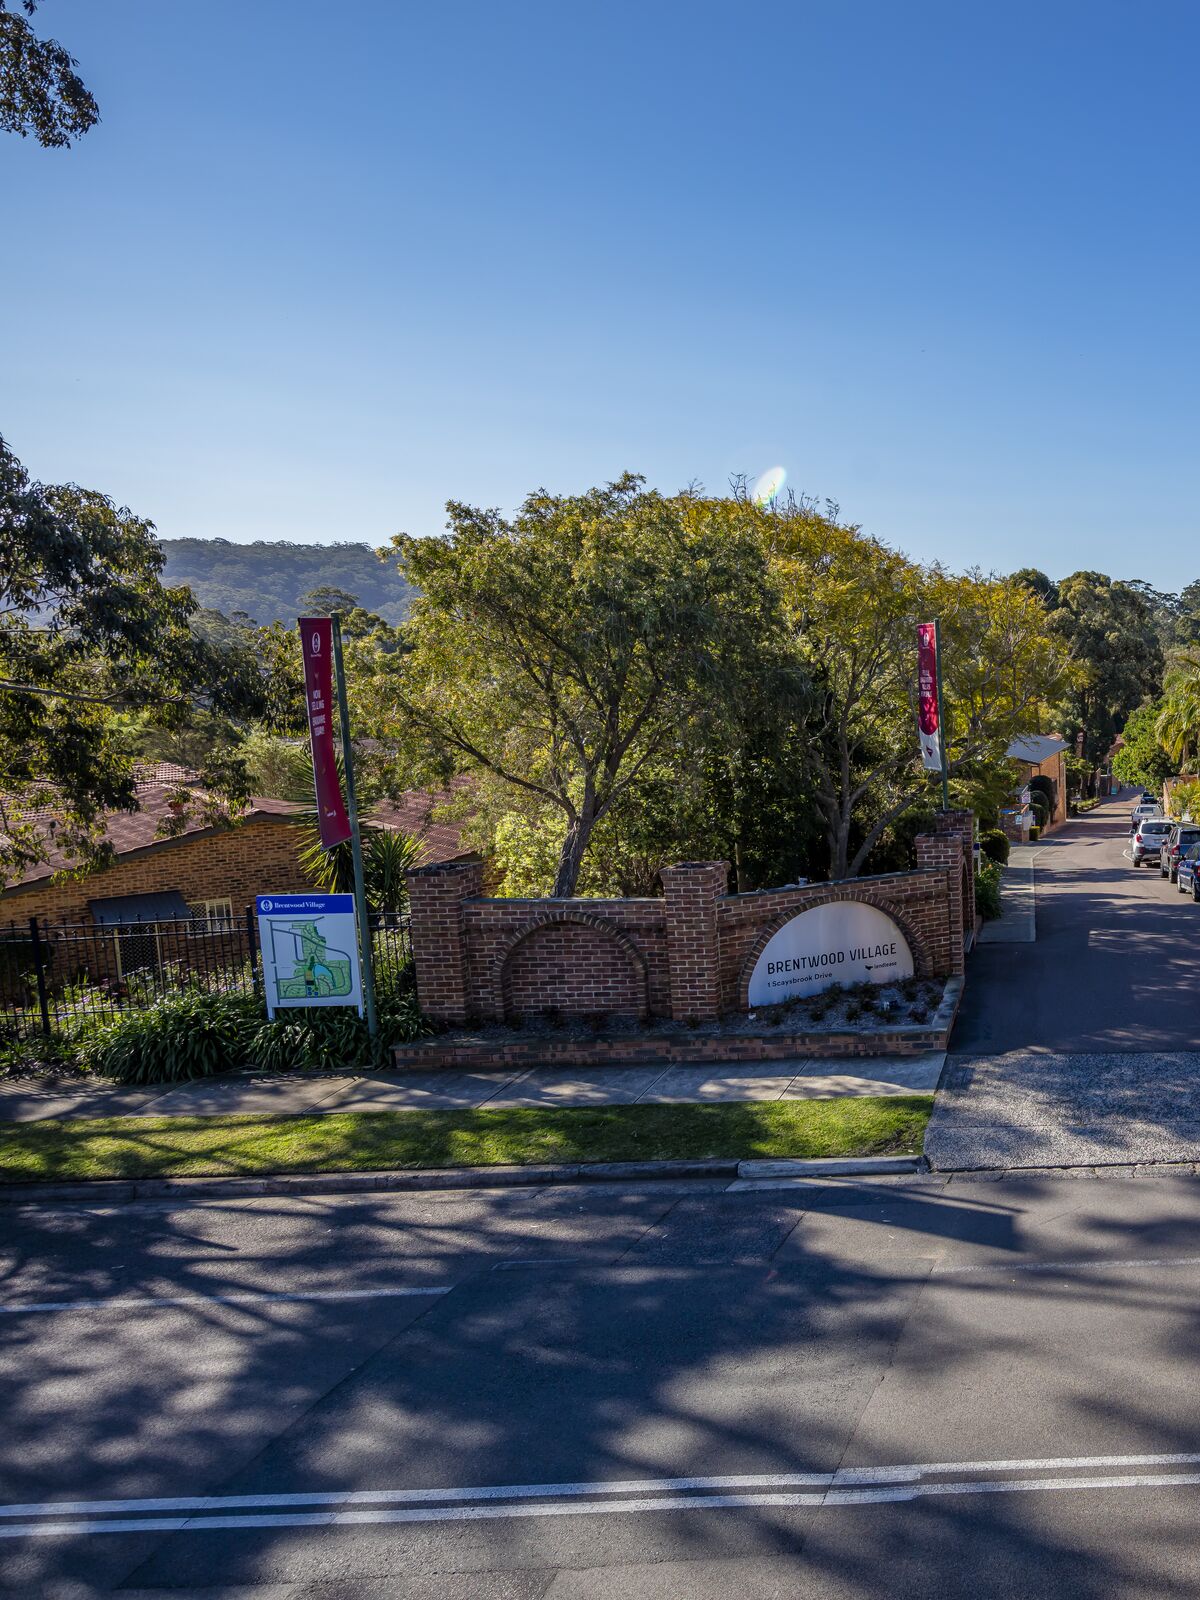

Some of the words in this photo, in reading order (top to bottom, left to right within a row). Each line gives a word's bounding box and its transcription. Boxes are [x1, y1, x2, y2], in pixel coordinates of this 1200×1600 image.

[305, 901, 326, 909] Village
[767, 951, 845, 975] BRENTWOOD
[849, 942, 897, 961] VILLAGE
[772, 975, 813, 987] Scaysbrook
[814, 972, 833, 980] Drive
